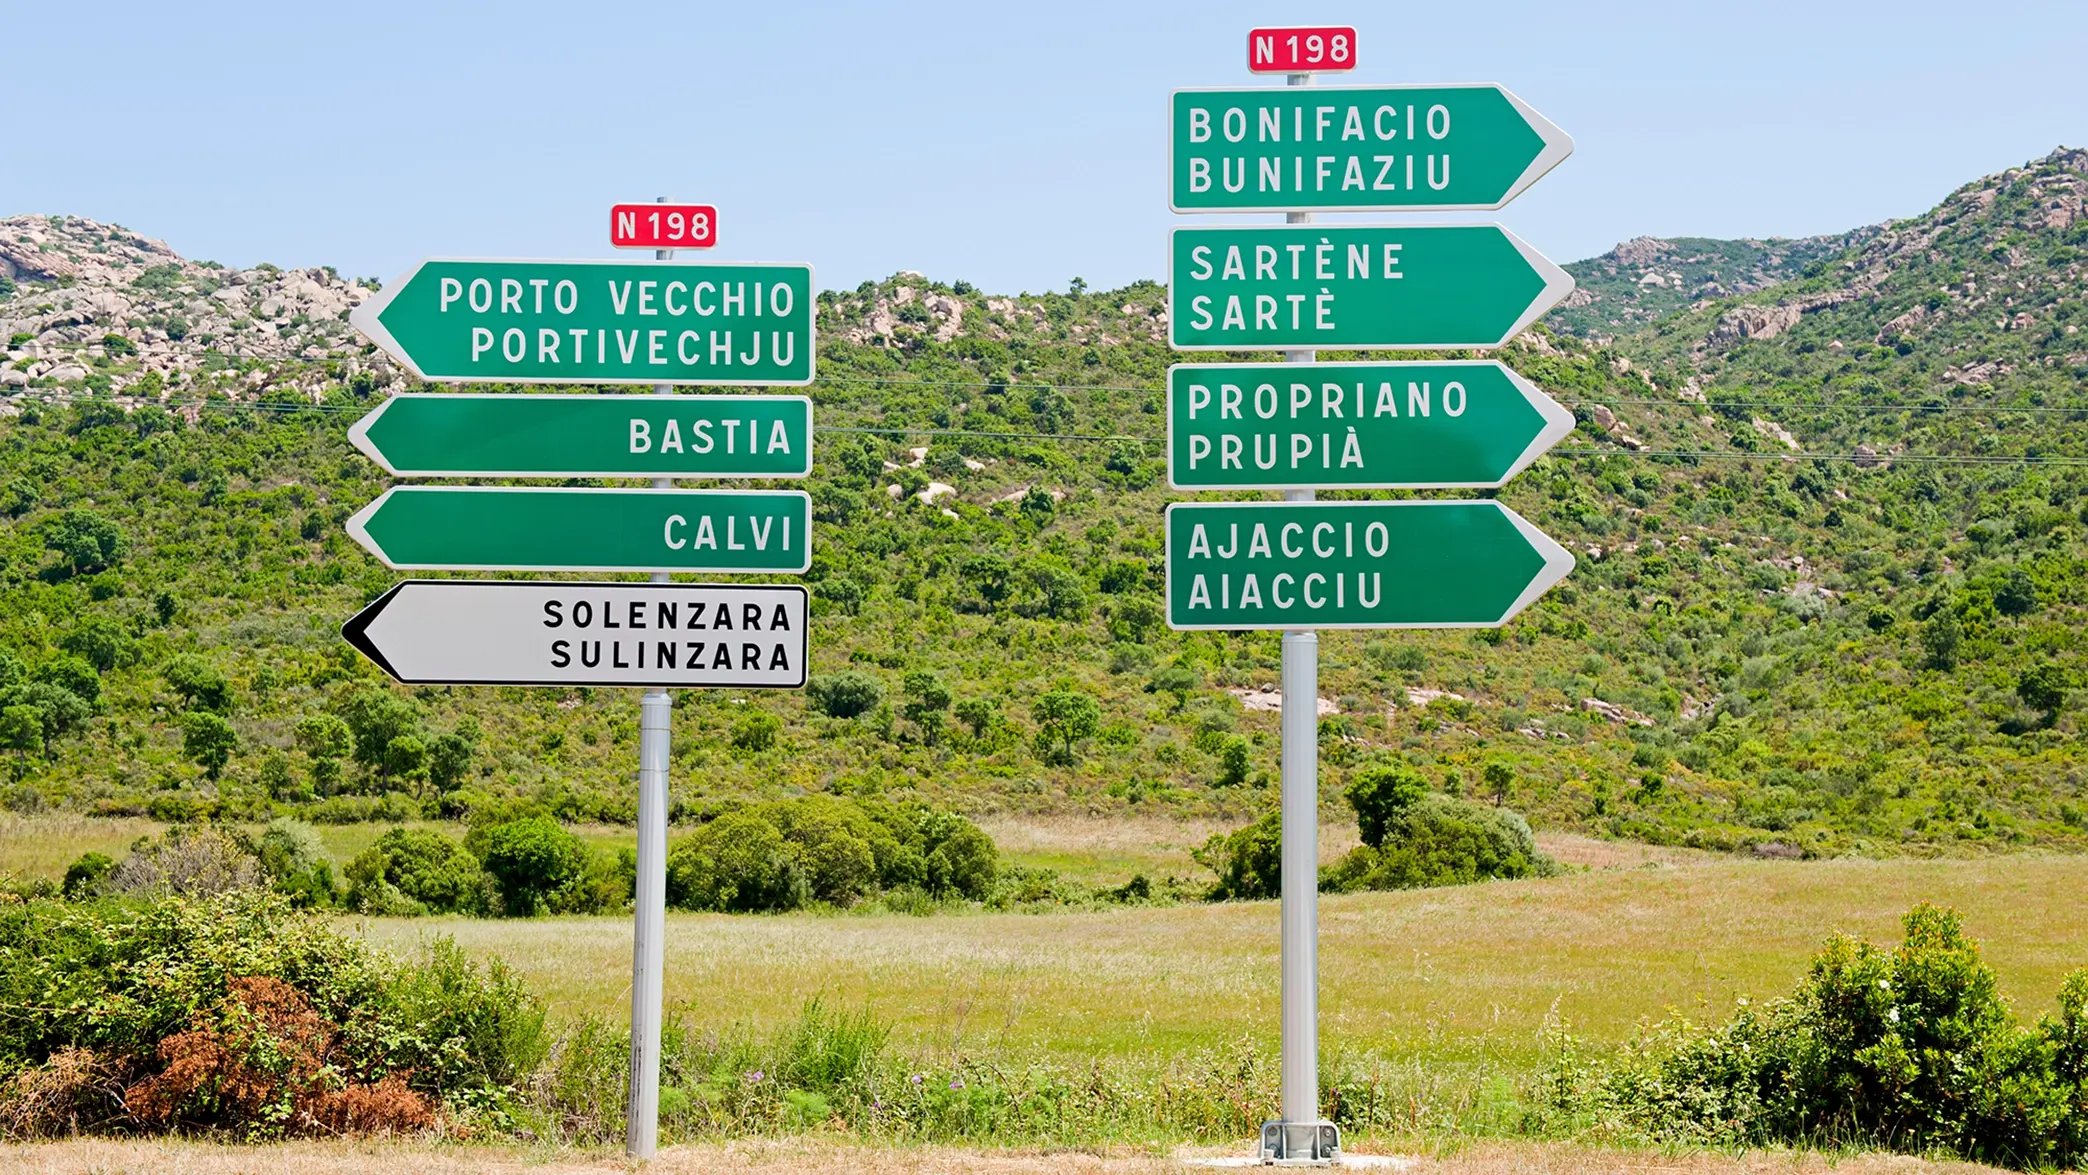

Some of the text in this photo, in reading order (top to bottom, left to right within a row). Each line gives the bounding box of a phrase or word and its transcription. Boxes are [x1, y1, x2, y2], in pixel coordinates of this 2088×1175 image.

[1256, 34, 1349, 64] N 198
[1189, 104, 1450, 143] BONIFACIO
[1189, 154, 1450, 193] BUNIFAZIU
[618, 211, 710, 241] N 198
[1190, 237, 1403, 281] SARTÈNE
[440, 277, 794, 317] PORTO VECCHIO
[1190, 287, 1335, 331] SARTÈ
[472, 327, 794, 367] PORTIVECHJU
[1189, 381, 1467, 420] PROPRIANO
[629, 418, 790, 454] BASTIA
[1189, 426, 1364, 470] PRUPIÀ
[664, 514, 790, 551] CALVI
[1187, 521, 1389, 559] AJACCIO
[1188, 572, 1381, 609] AIACCIU
[543, 599, 791, 632] SOLENZARA
[550, 639, 790, 671] SULINZARA
